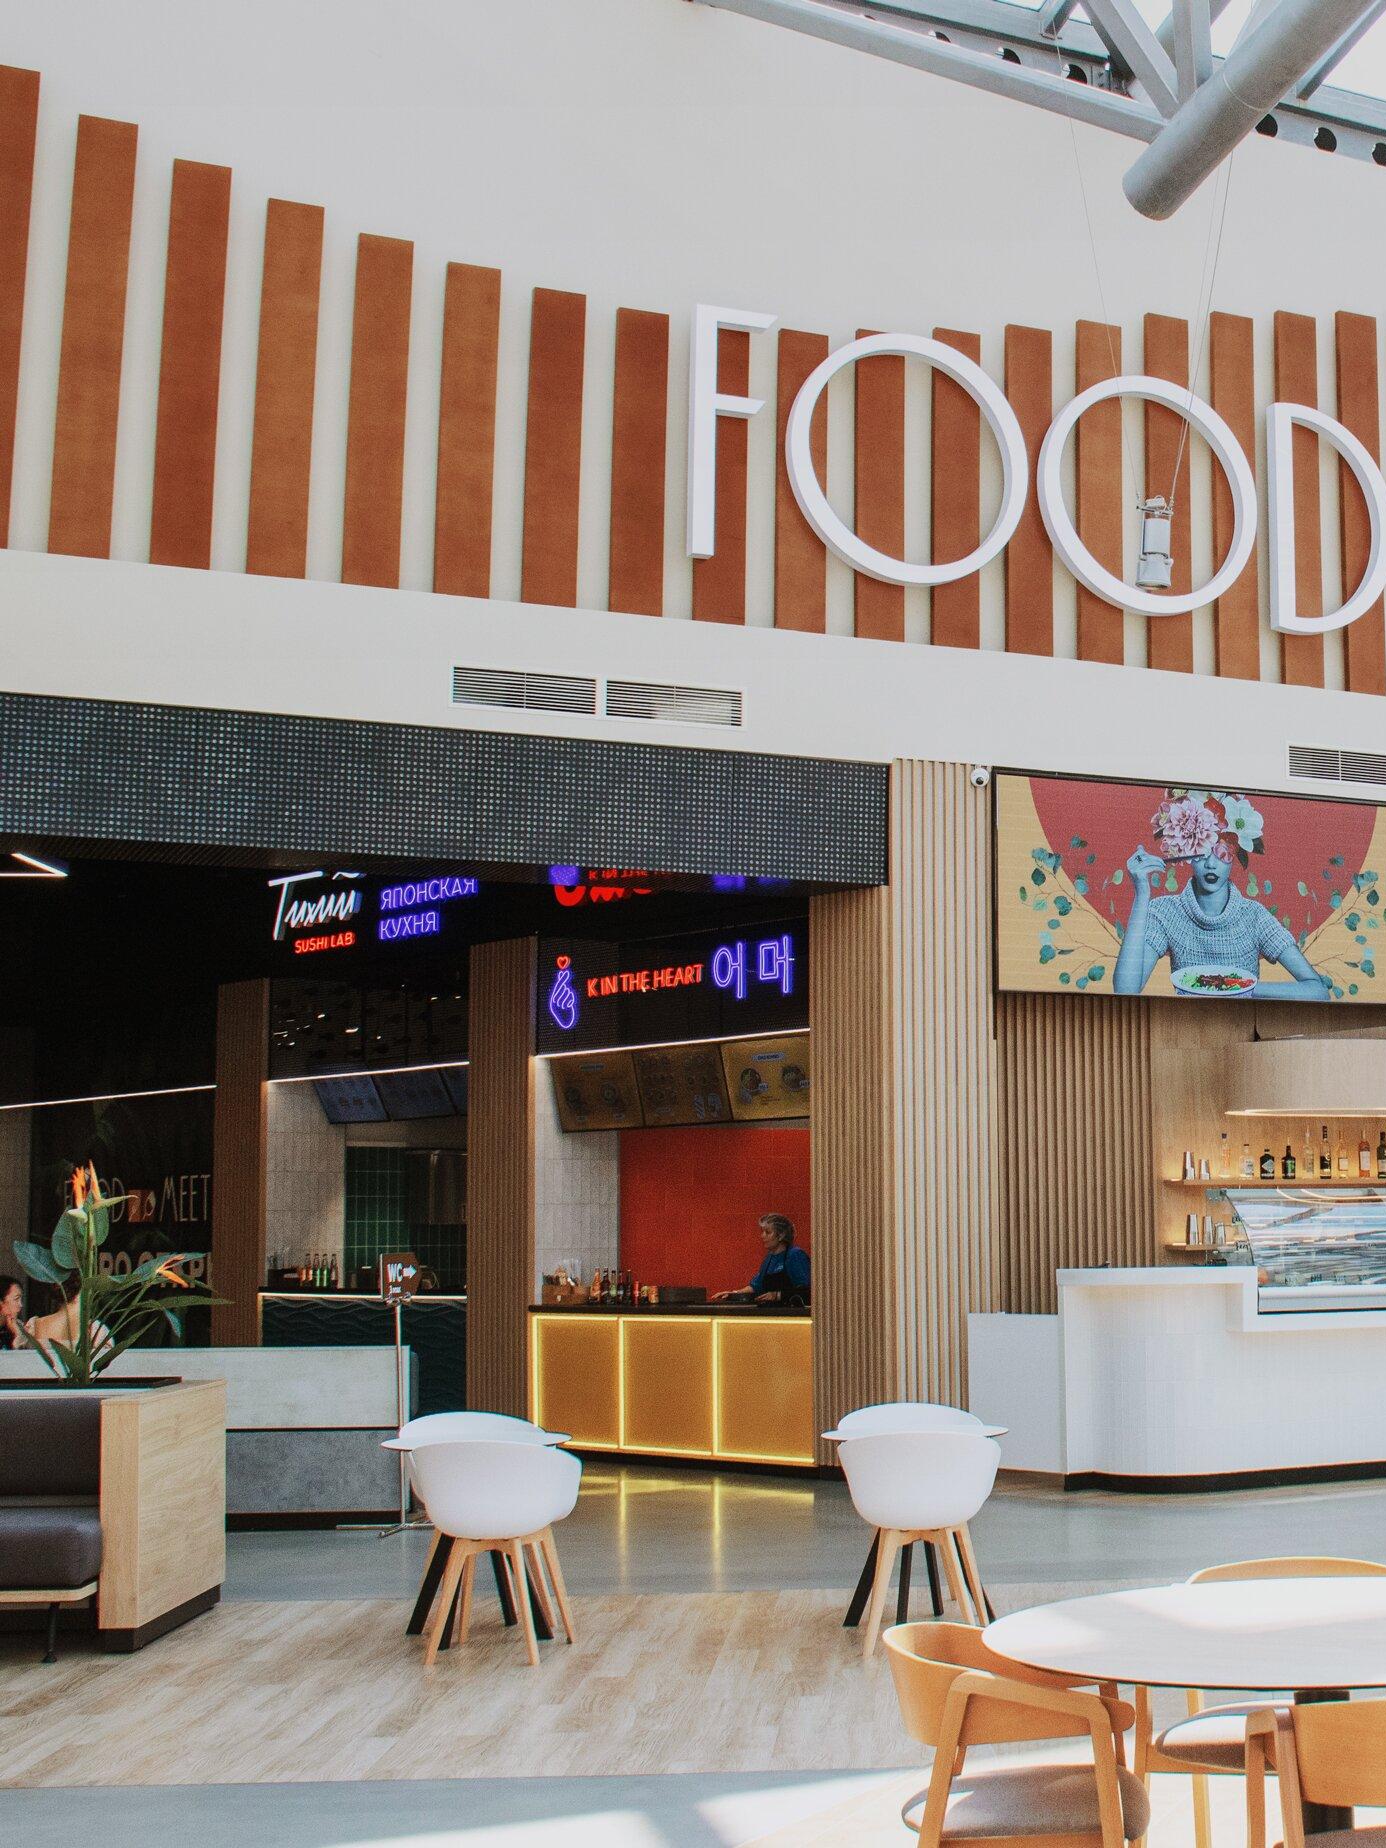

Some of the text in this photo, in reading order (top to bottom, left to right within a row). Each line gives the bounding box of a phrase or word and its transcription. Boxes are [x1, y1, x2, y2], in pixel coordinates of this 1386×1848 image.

[379, 877, 477, 911] ЯПОНСКАЯ
[379, 911, 437, 940] КУХНЯ
[294, 931, 355, 954] SUSHI LAB
[586, 964, 703, 998] K IN THE HEART
[159, 1174, 212, 1224] MEET
[387, 1262, 403, 1283] WC
